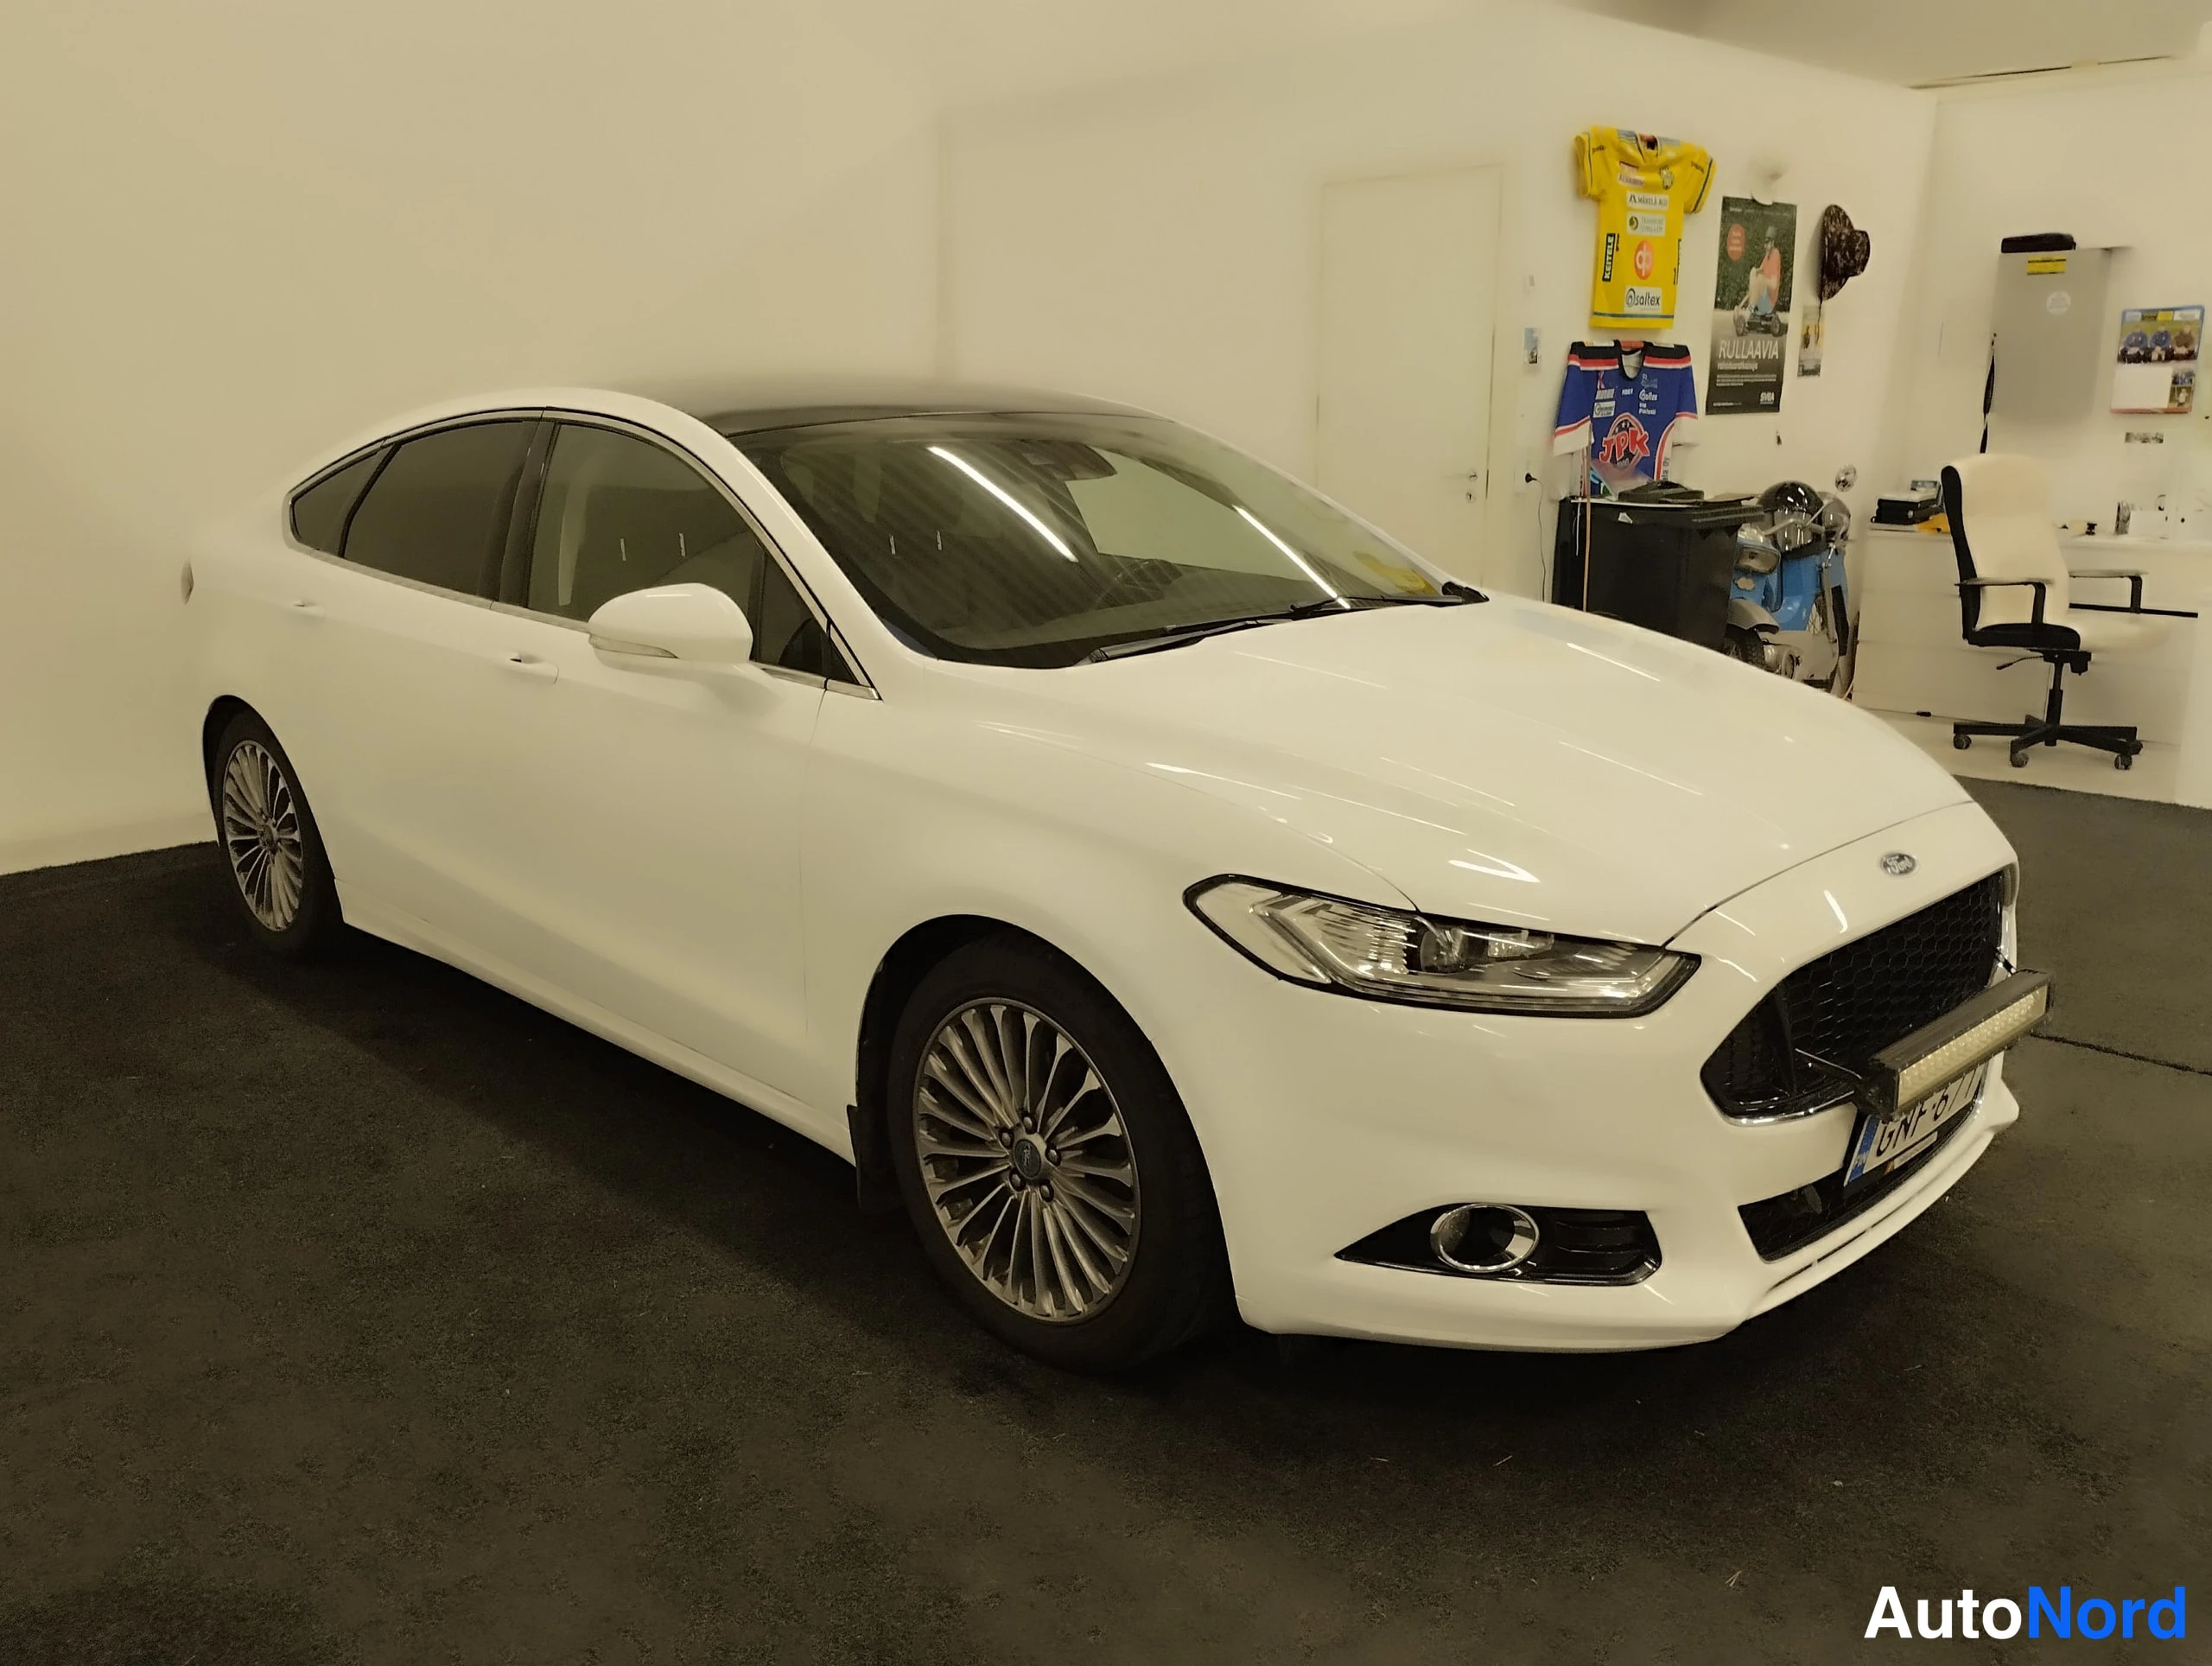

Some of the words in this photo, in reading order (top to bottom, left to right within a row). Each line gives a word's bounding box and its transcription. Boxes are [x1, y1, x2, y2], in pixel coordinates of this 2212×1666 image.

[1604, 235, 1615, 279] KEITELE
[1634, 290, 1661, 307] saltex
[1719, 340, 1779, 359] RULLAAVIA
[1599, 427, 1650, 463] JPK
